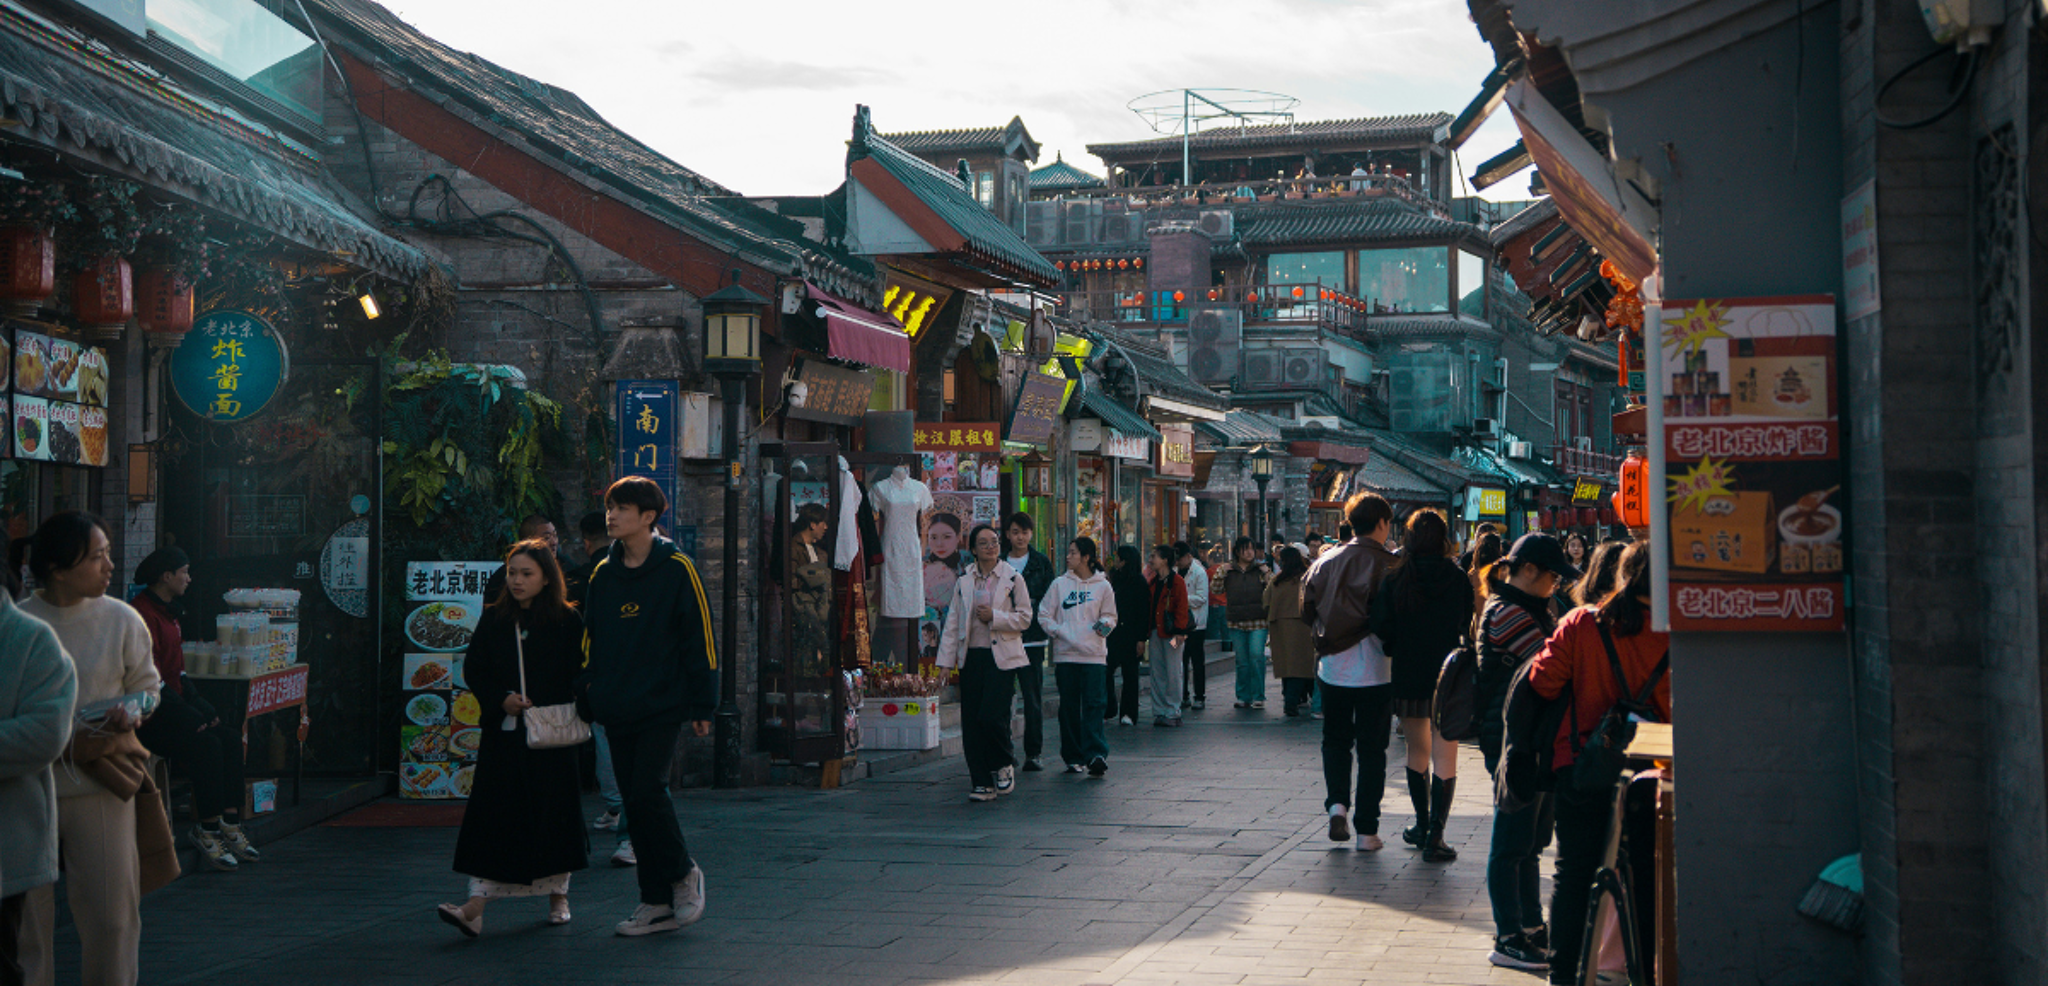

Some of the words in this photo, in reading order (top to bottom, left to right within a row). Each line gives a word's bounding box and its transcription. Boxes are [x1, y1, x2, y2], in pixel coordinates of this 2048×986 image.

[202, 319, 254, 338] 老北京
[634, 404, 660, 471] 南门
[913, 429, 994, 446] 妆汉服租售
[1672, 426, 1829, 458] 老北京炸酱
[296, 561, 311, 577] 推
[1677, 587, 1835, 619] 老北京二八酱
